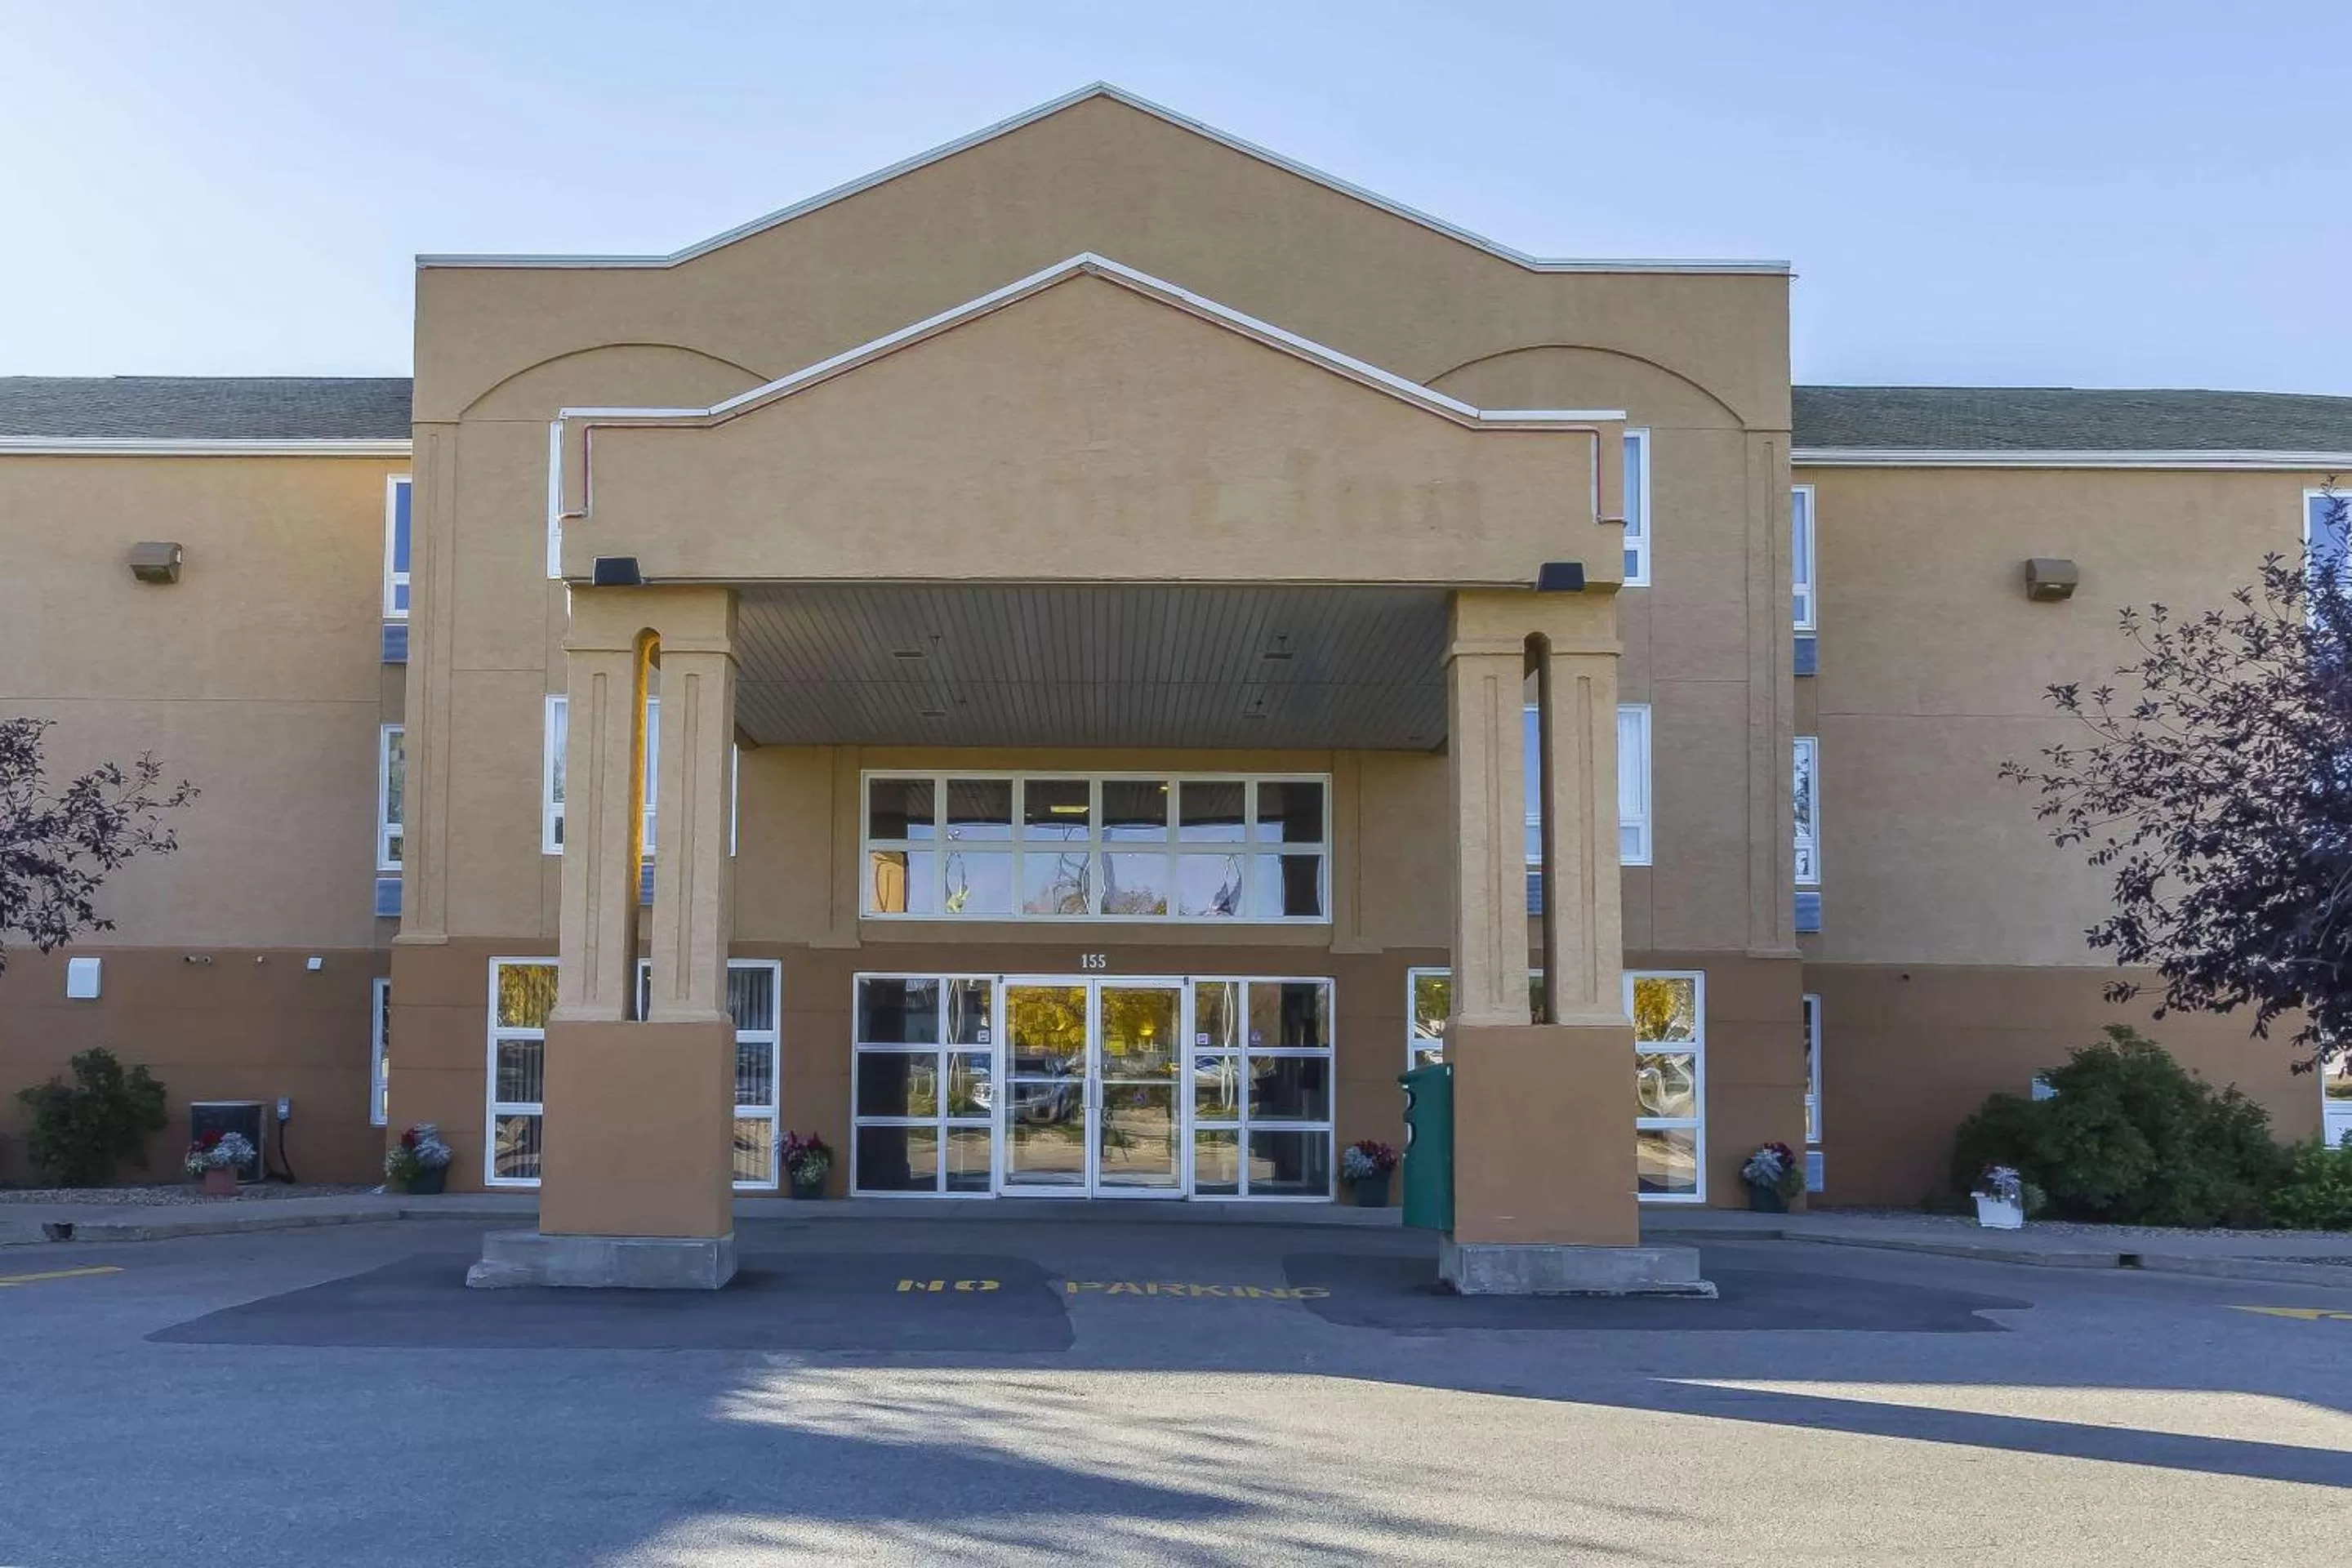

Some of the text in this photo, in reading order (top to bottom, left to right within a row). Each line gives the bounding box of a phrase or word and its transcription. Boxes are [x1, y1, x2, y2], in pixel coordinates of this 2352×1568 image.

[1081, 953, 1106, 968] 155
[897, 1280, 1330, 1298] NO PARKING
